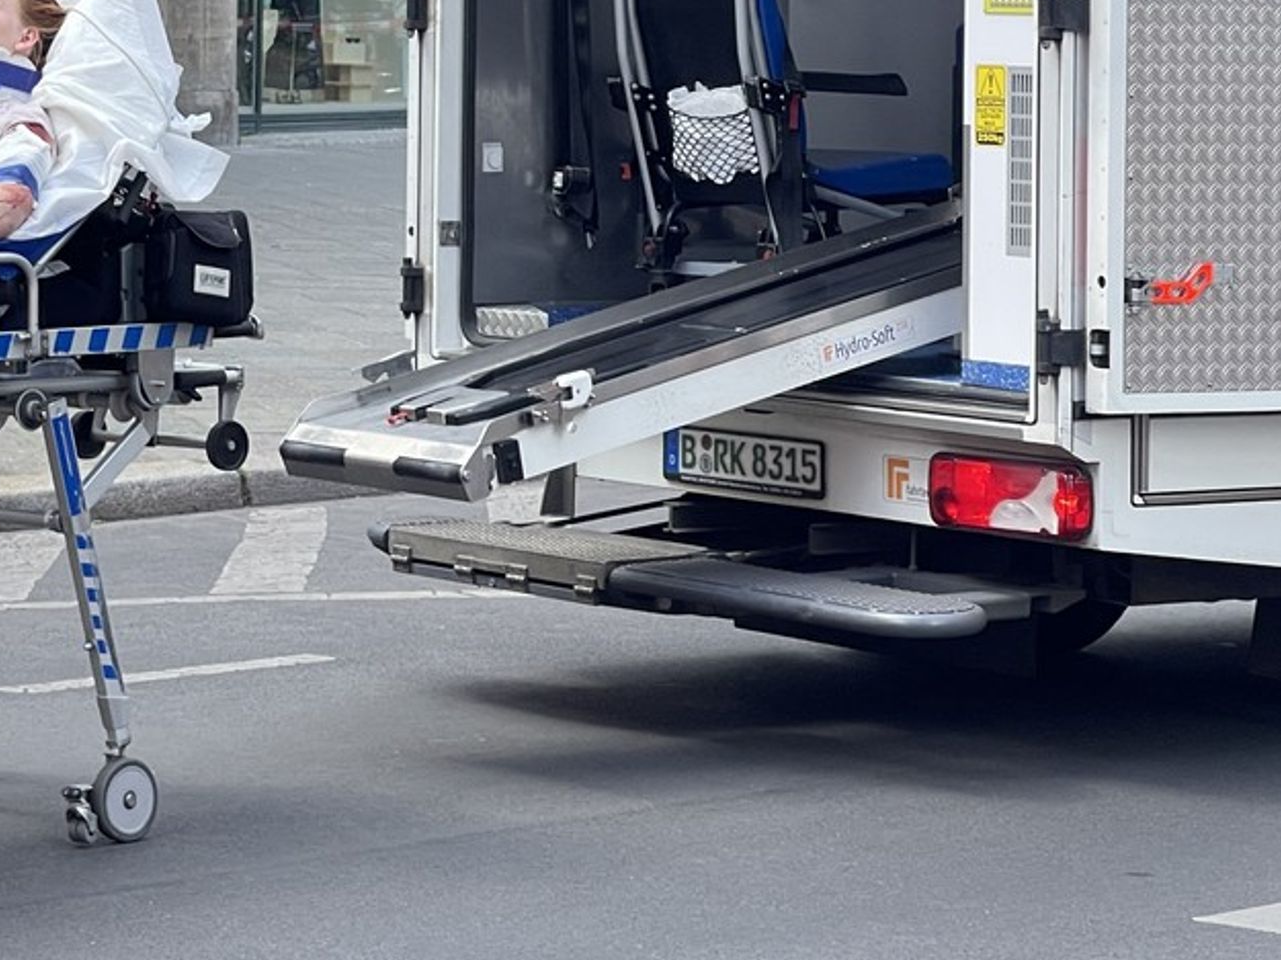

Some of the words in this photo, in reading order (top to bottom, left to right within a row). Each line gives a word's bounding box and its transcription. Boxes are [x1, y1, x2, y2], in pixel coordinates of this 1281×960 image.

[834, 324, 896, 360] Hydro-Soft
[681, 434, 697, 470] B
[714, 438, 747, 477] RK
[753, 443, 818, 484] 8315
